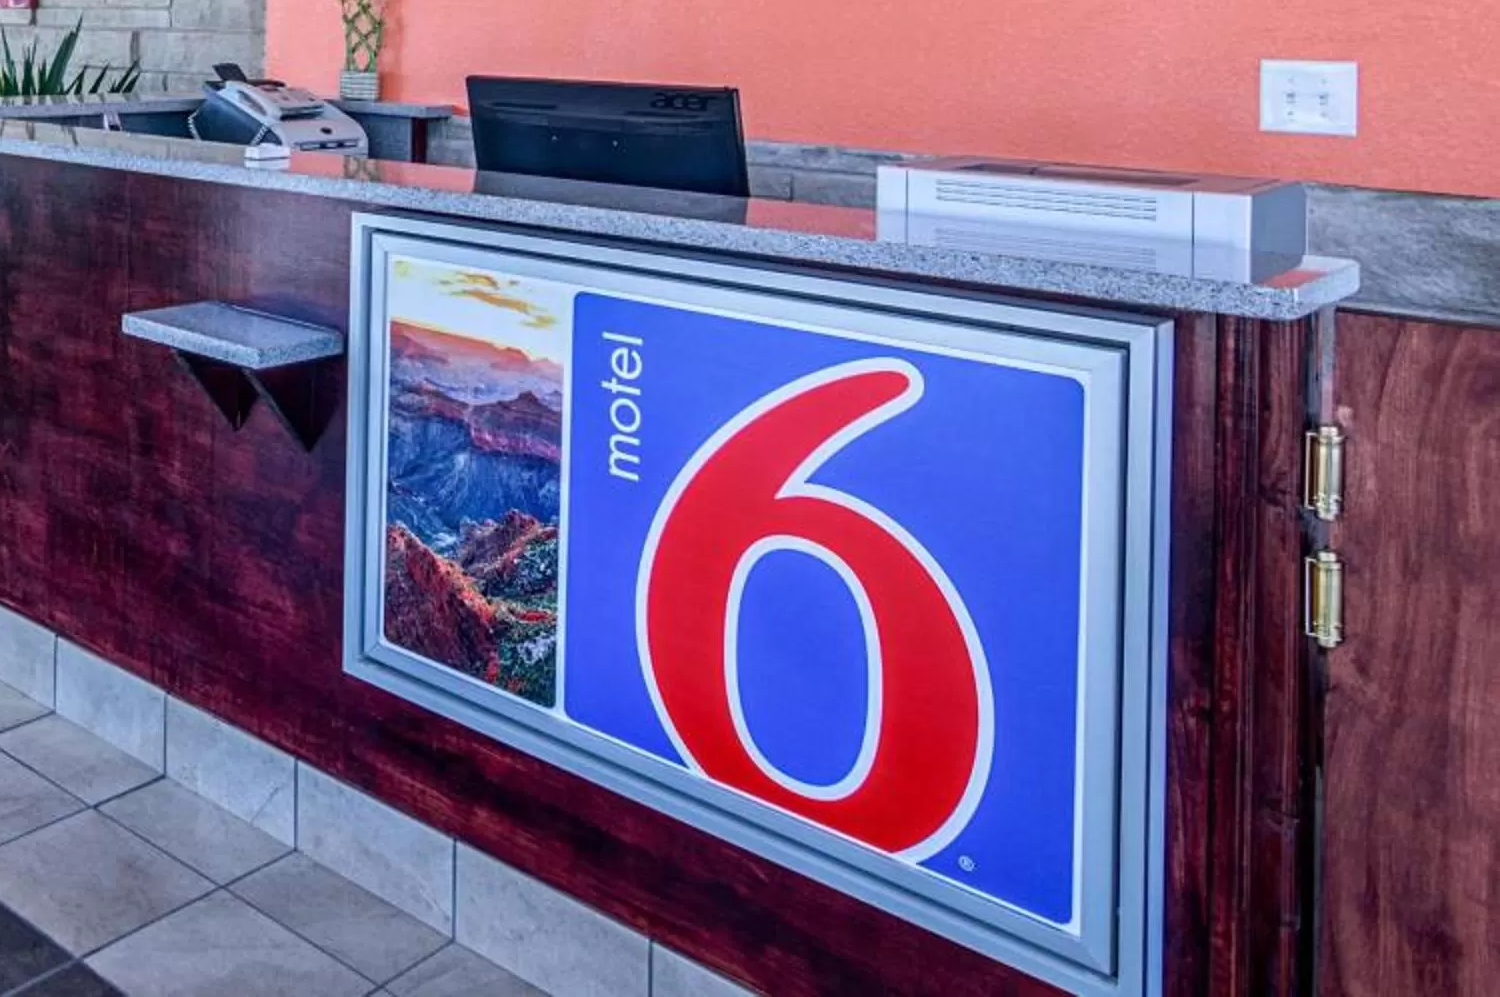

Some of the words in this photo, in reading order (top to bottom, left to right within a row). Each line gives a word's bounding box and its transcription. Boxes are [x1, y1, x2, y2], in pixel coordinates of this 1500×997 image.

[651, 92, 716, 111] acer
[601, 330, 644, 483] motel
[636, 357, 994, 864] 6
